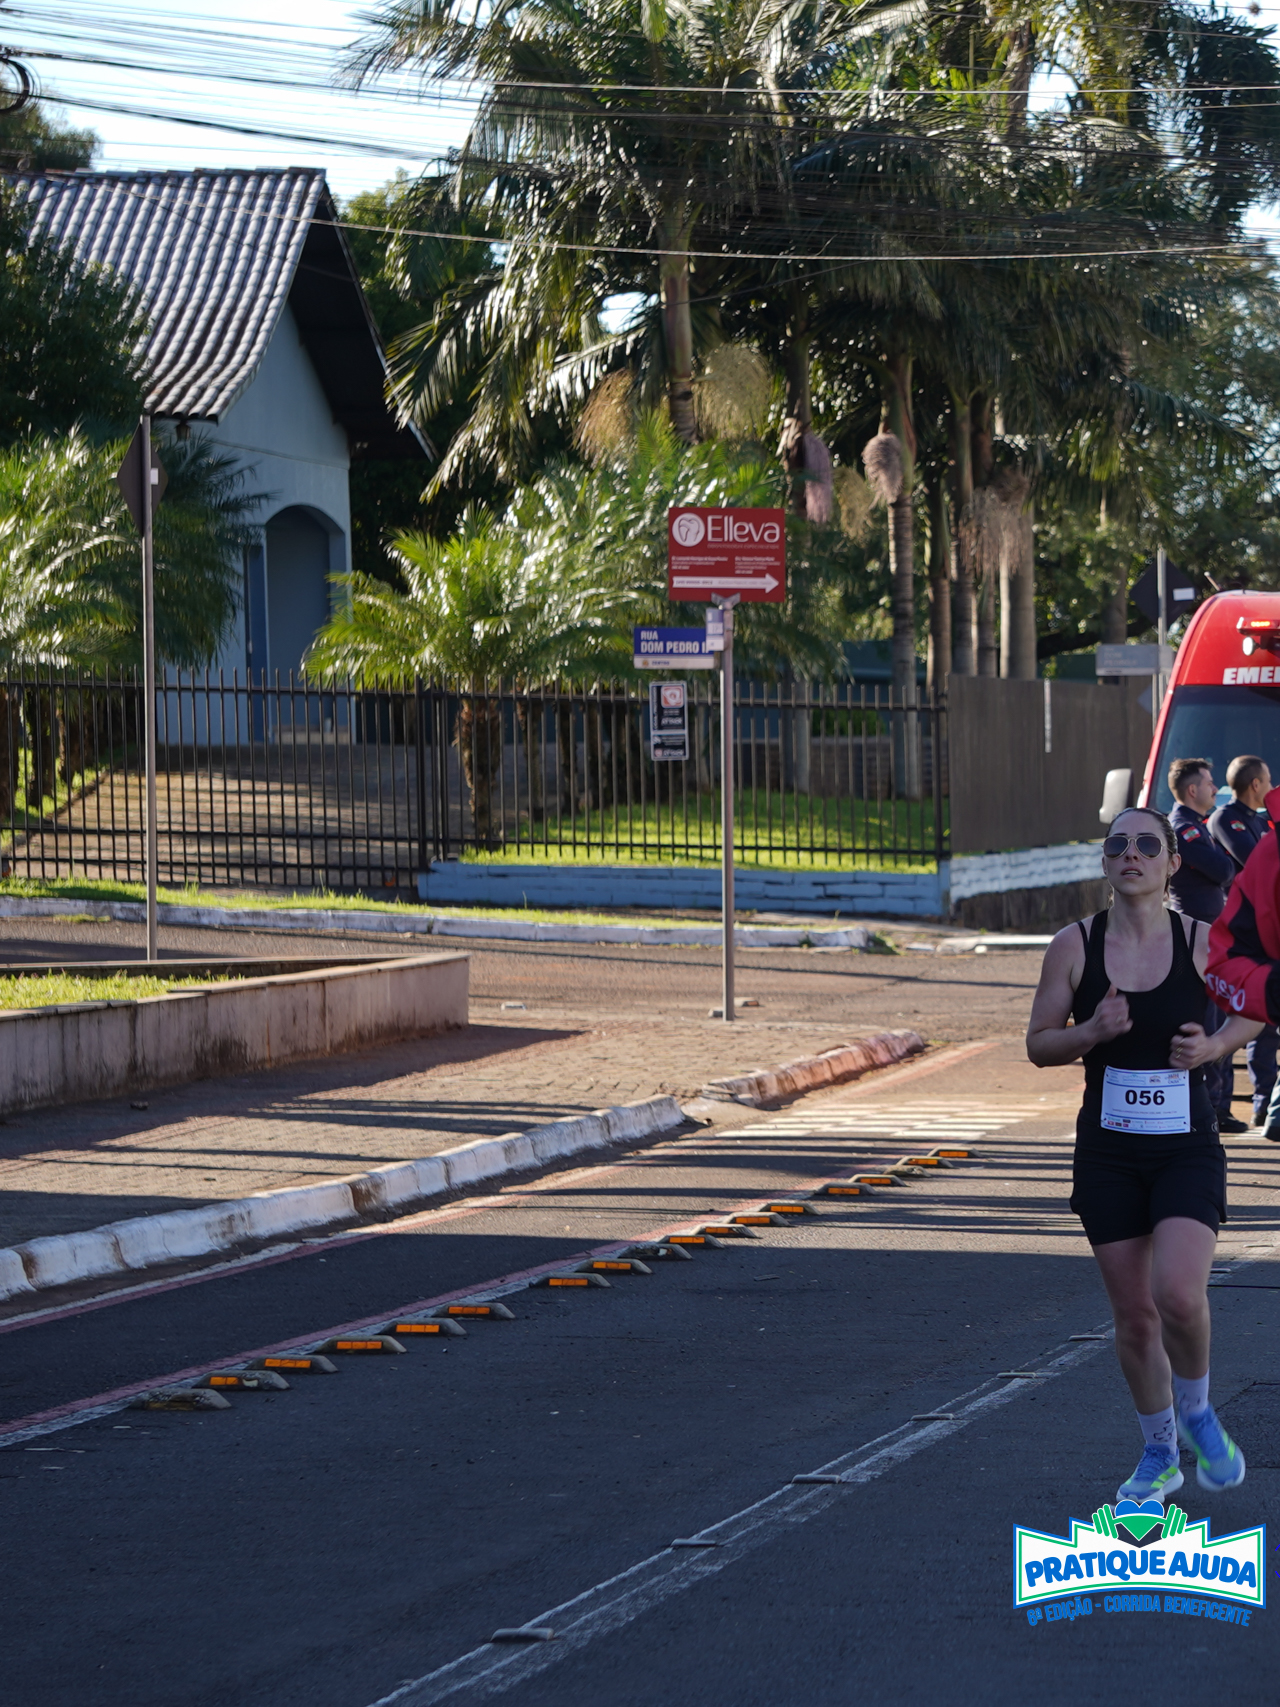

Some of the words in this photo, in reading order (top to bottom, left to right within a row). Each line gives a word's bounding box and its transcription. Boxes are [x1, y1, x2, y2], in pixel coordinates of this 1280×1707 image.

[707, 514, 780, 543] Elleva
[640, 630, 659, 641] RUA
[640, 641, 664, 653] DOM
[666, 641, 700, 653] PEDRO
[1125, 1089, 1165, 1106] 056
